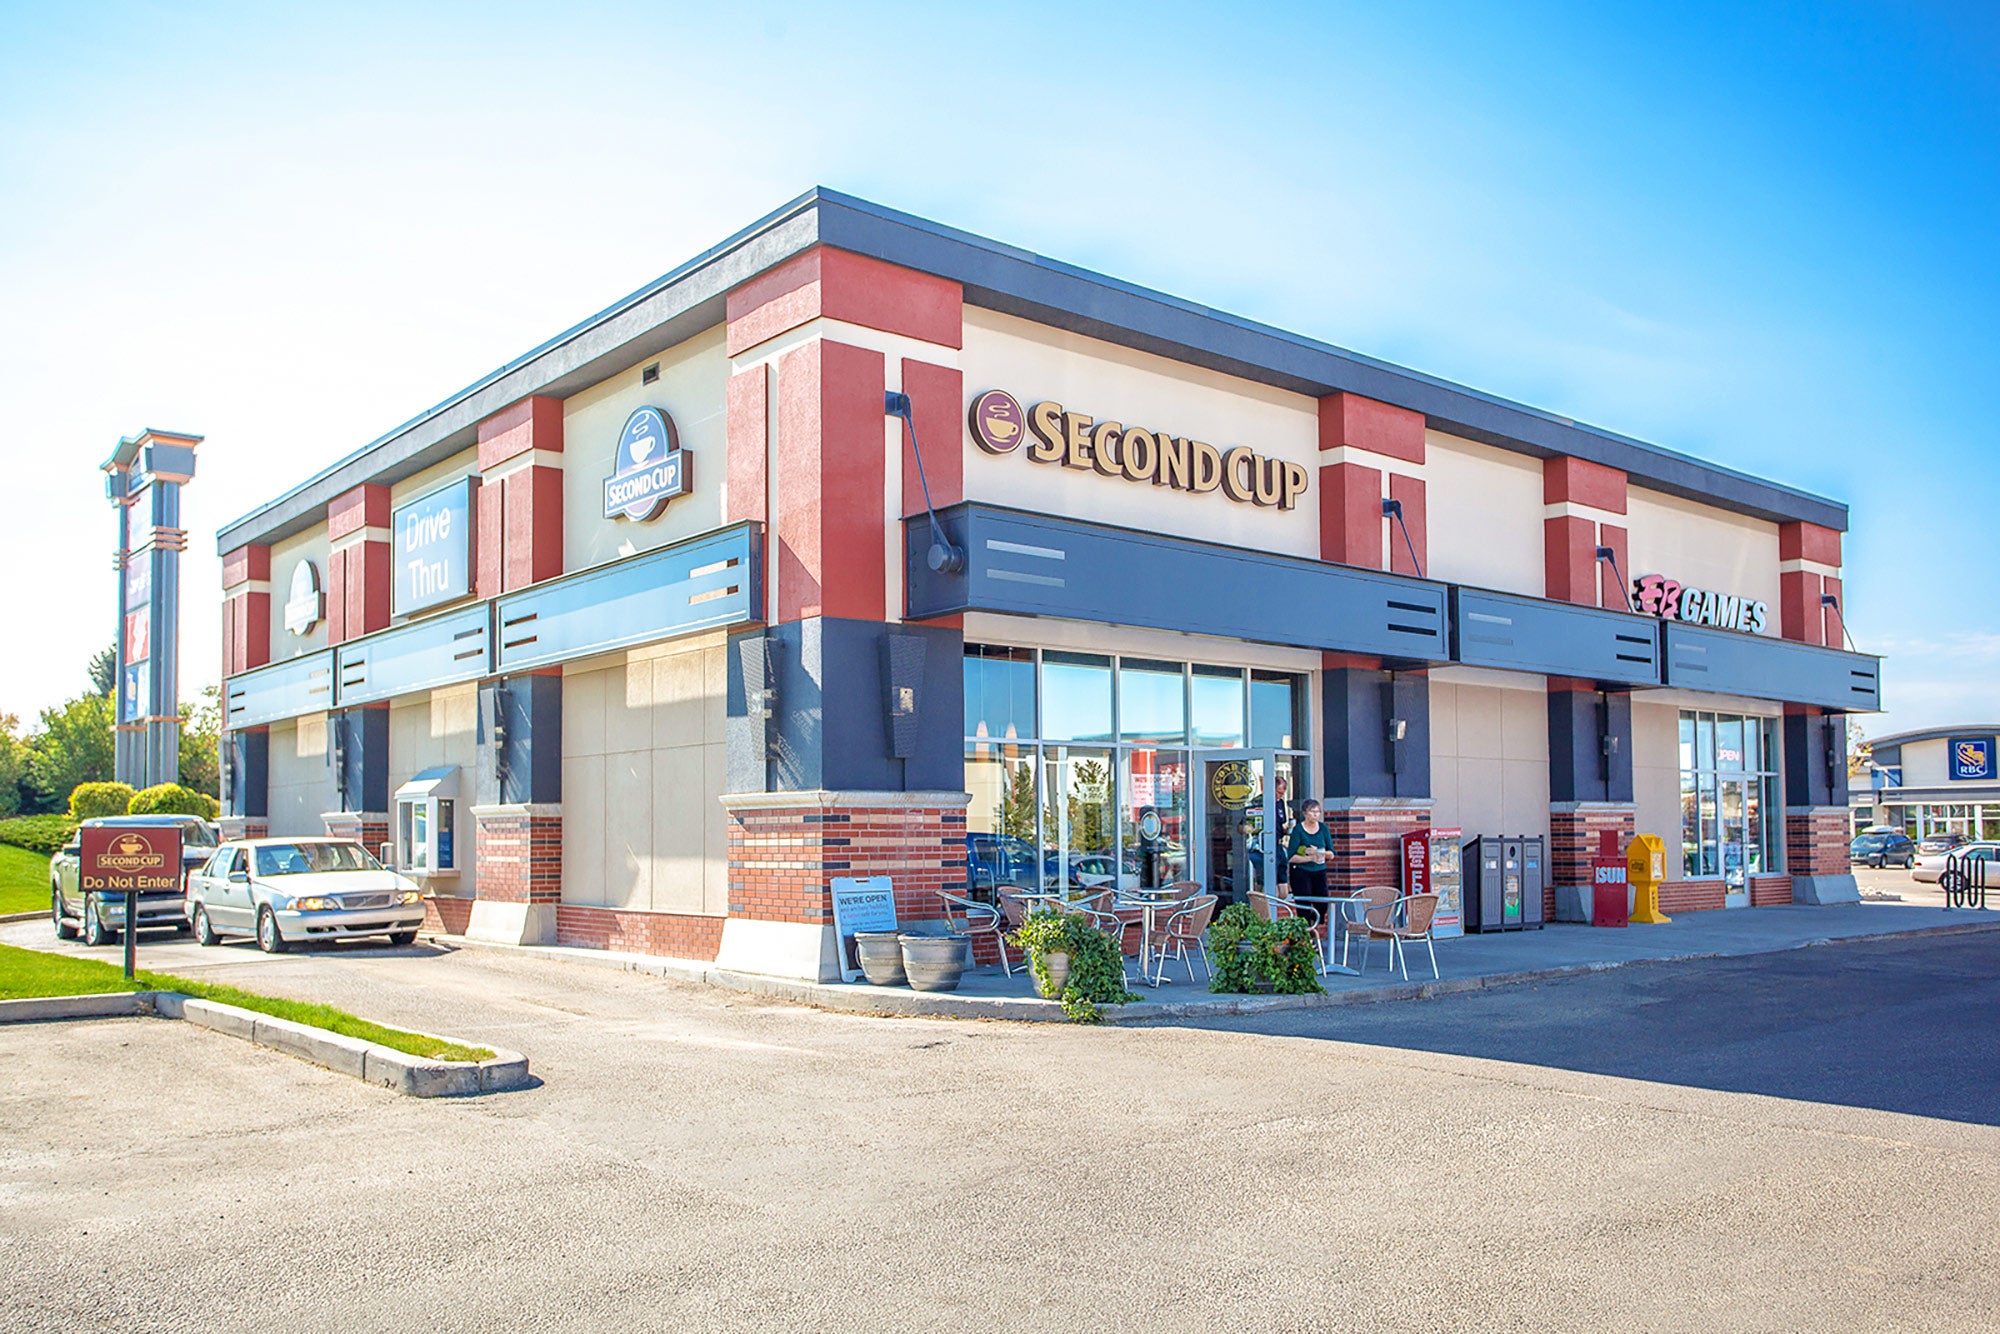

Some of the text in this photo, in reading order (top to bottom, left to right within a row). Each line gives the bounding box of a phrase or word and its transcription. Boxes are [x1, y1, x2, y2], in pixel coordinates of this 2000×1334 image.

[1027, 401, 1308, 510] SECOND CUP
[609, 464, 677, 506] SECOND CUP
[406, 506, 451, 553] Drive
[408, 558, 449, 600] Thru
[1633, 574, 1768, 634] EB GAMES
[1960, 766, 1984, 774] RBC
[100, 856, 161, 866] SECOND CUP
[1600, 867, 1627, 884] SUN
[83, 876, 176, 889] Do Not Enter
[865, 894, 887, 903] OPEN
